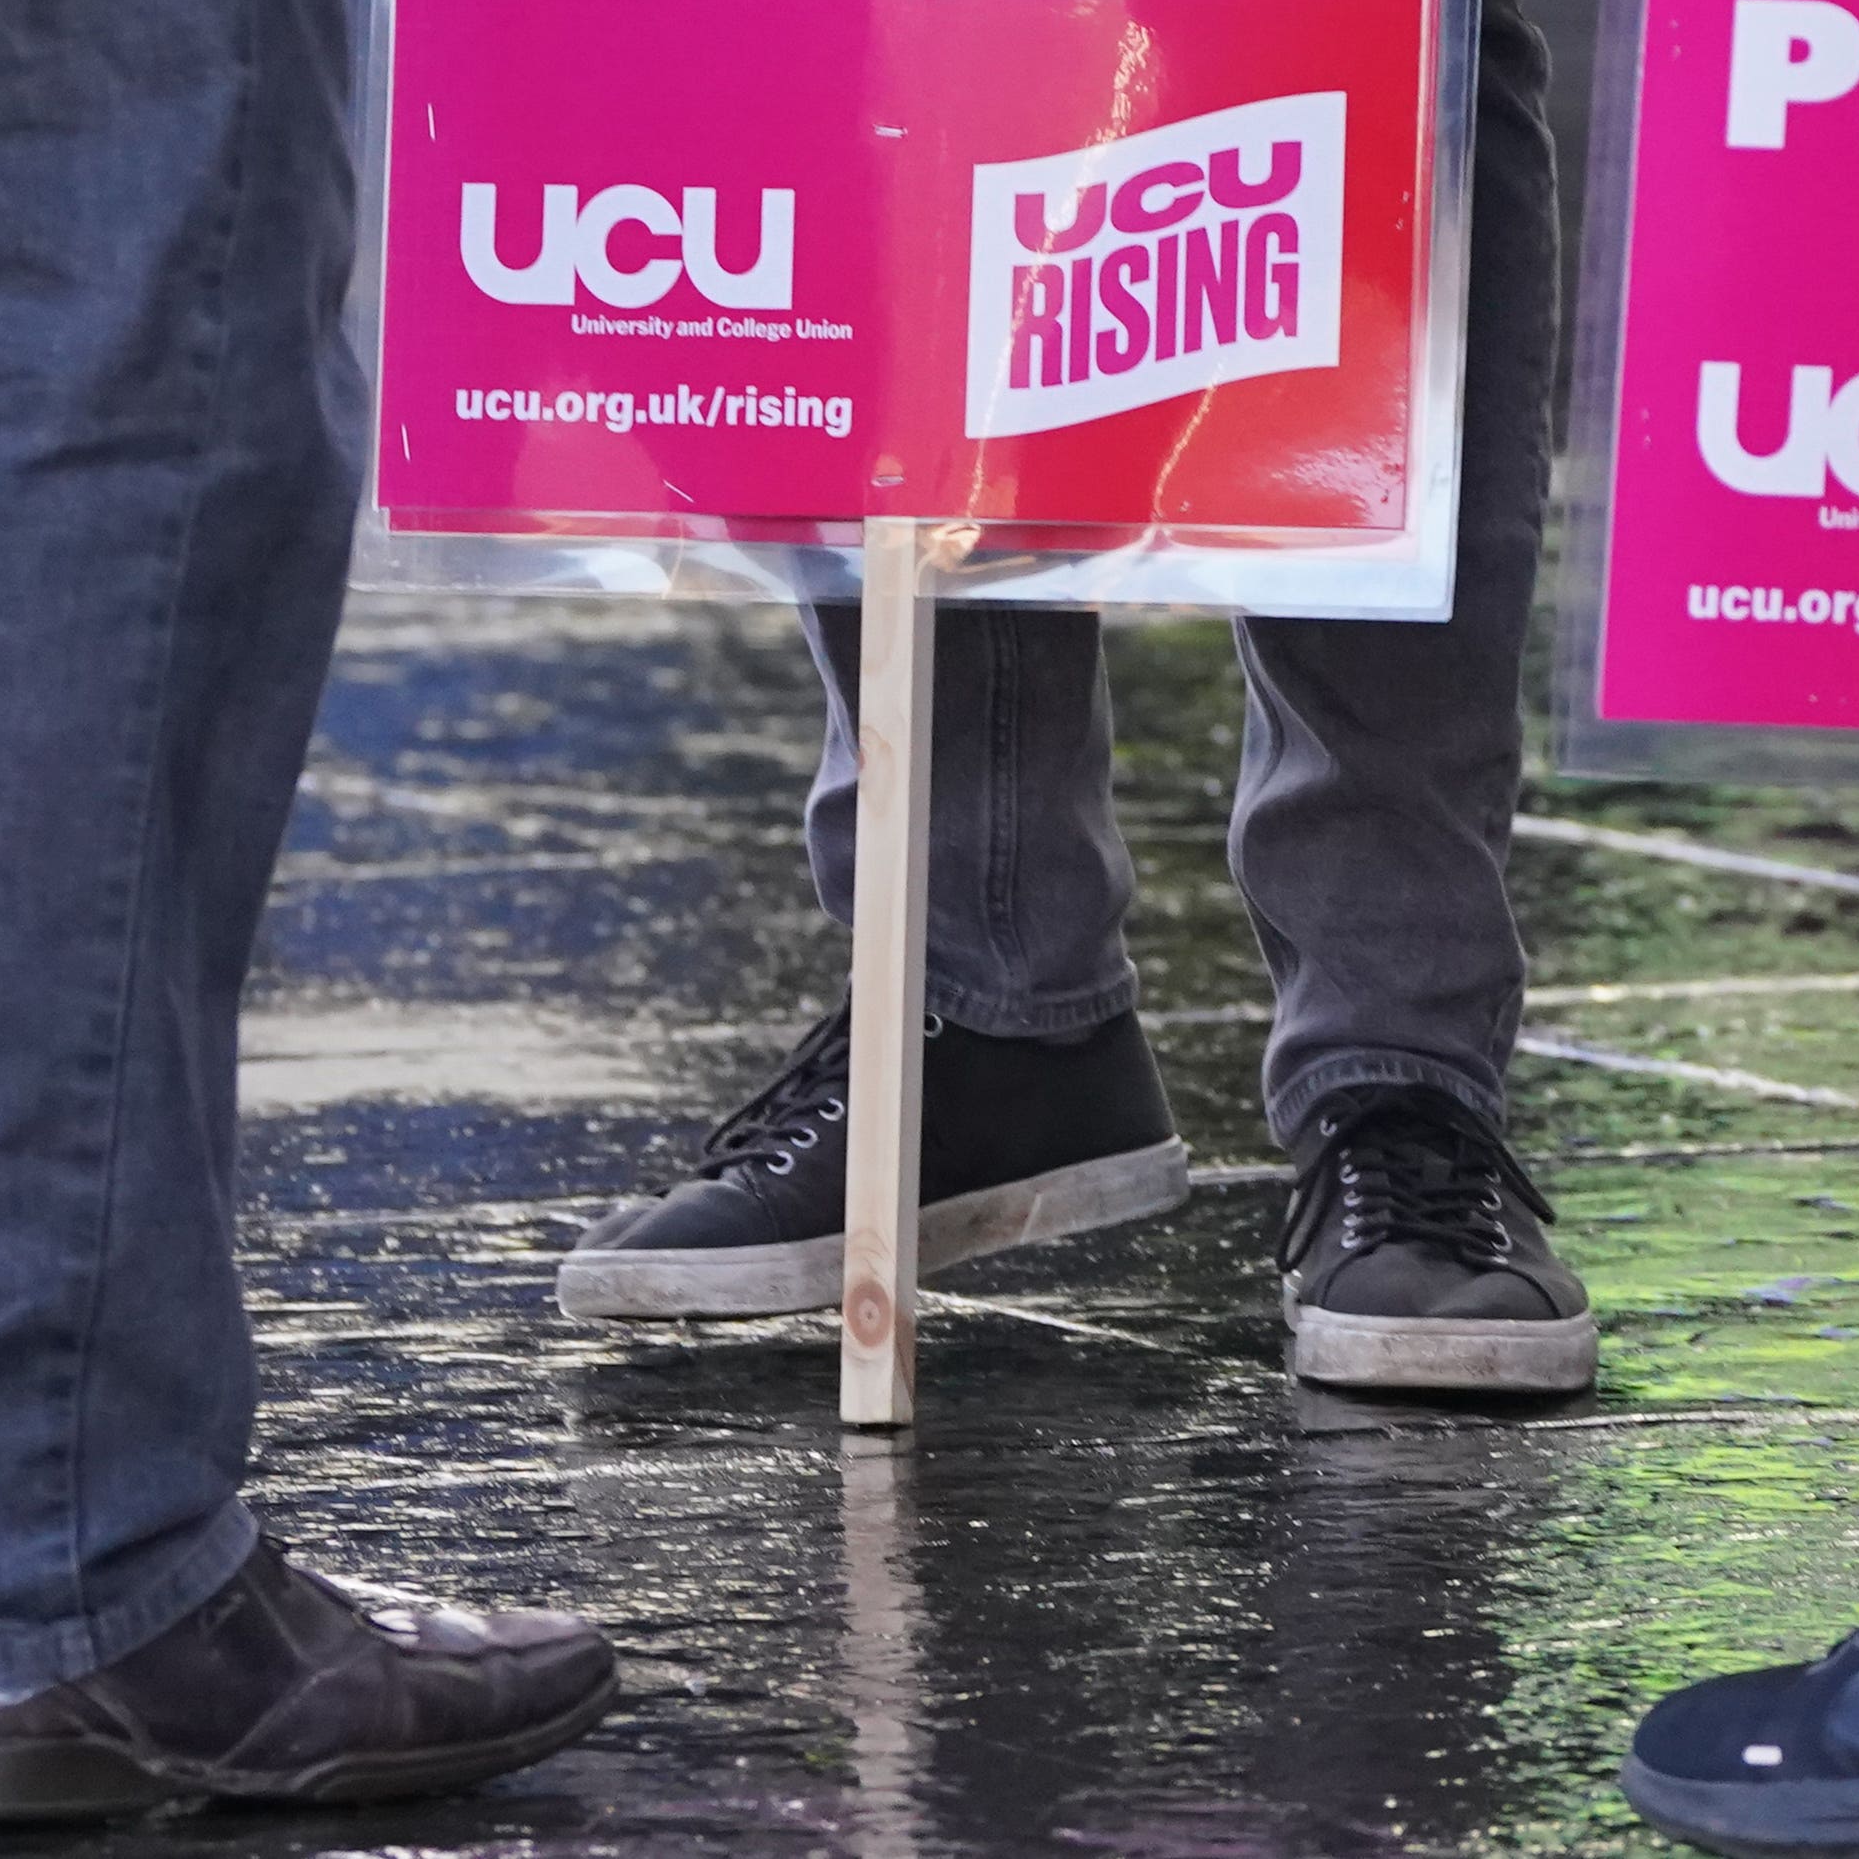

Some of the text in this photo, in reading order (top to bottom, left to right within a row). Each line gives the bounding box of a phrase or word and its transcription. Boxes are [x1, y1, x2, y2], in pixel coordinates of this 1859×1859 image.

[1013, 140, 1302, 254] UCU
[571, 314, 853, 342] University and College Union
[1009, 212, 1299, 389] RISING
[456, 384, 853, 438] ucu.org.uk/rising
